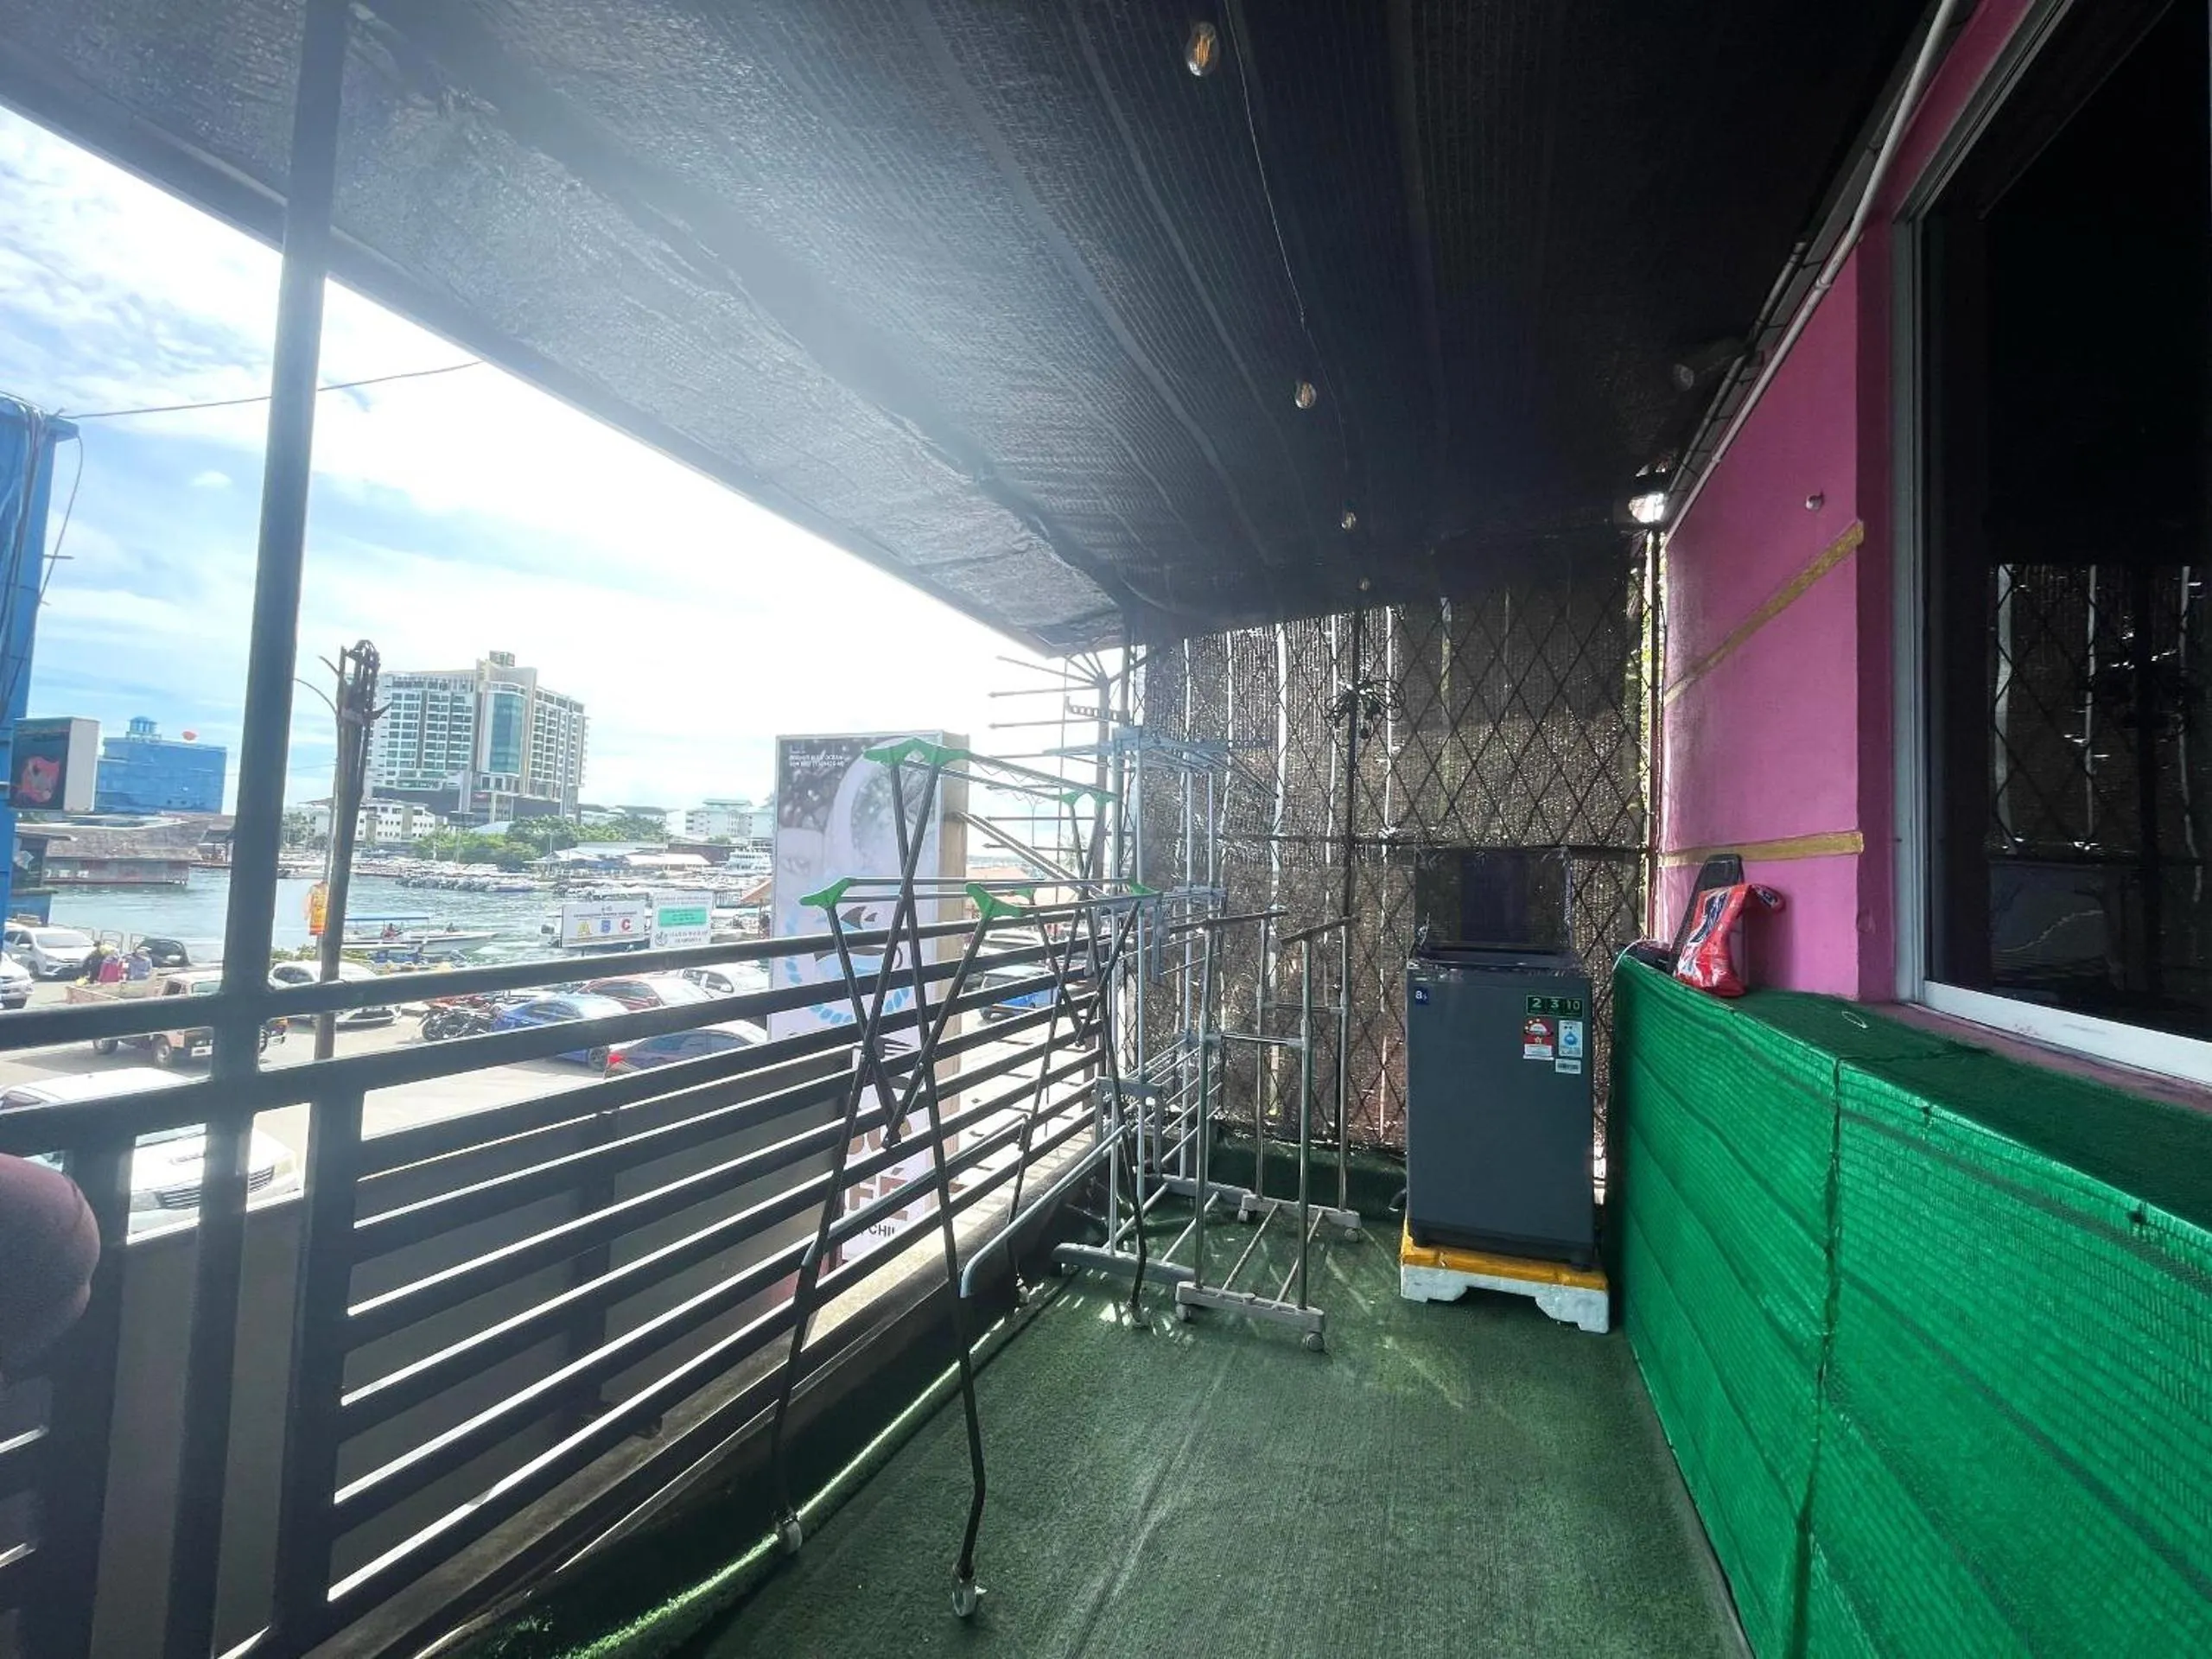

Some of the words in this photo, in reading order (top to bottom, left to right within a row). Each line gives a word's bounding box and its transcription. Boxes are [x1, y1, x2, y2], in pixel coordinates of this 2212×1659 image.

[621, 918, 631, 931] C
[1532, 997, 1542, 1008] 2
[1550, 999, 1560, 1008] 3
[1567, 999, 1580, 1010] 10
